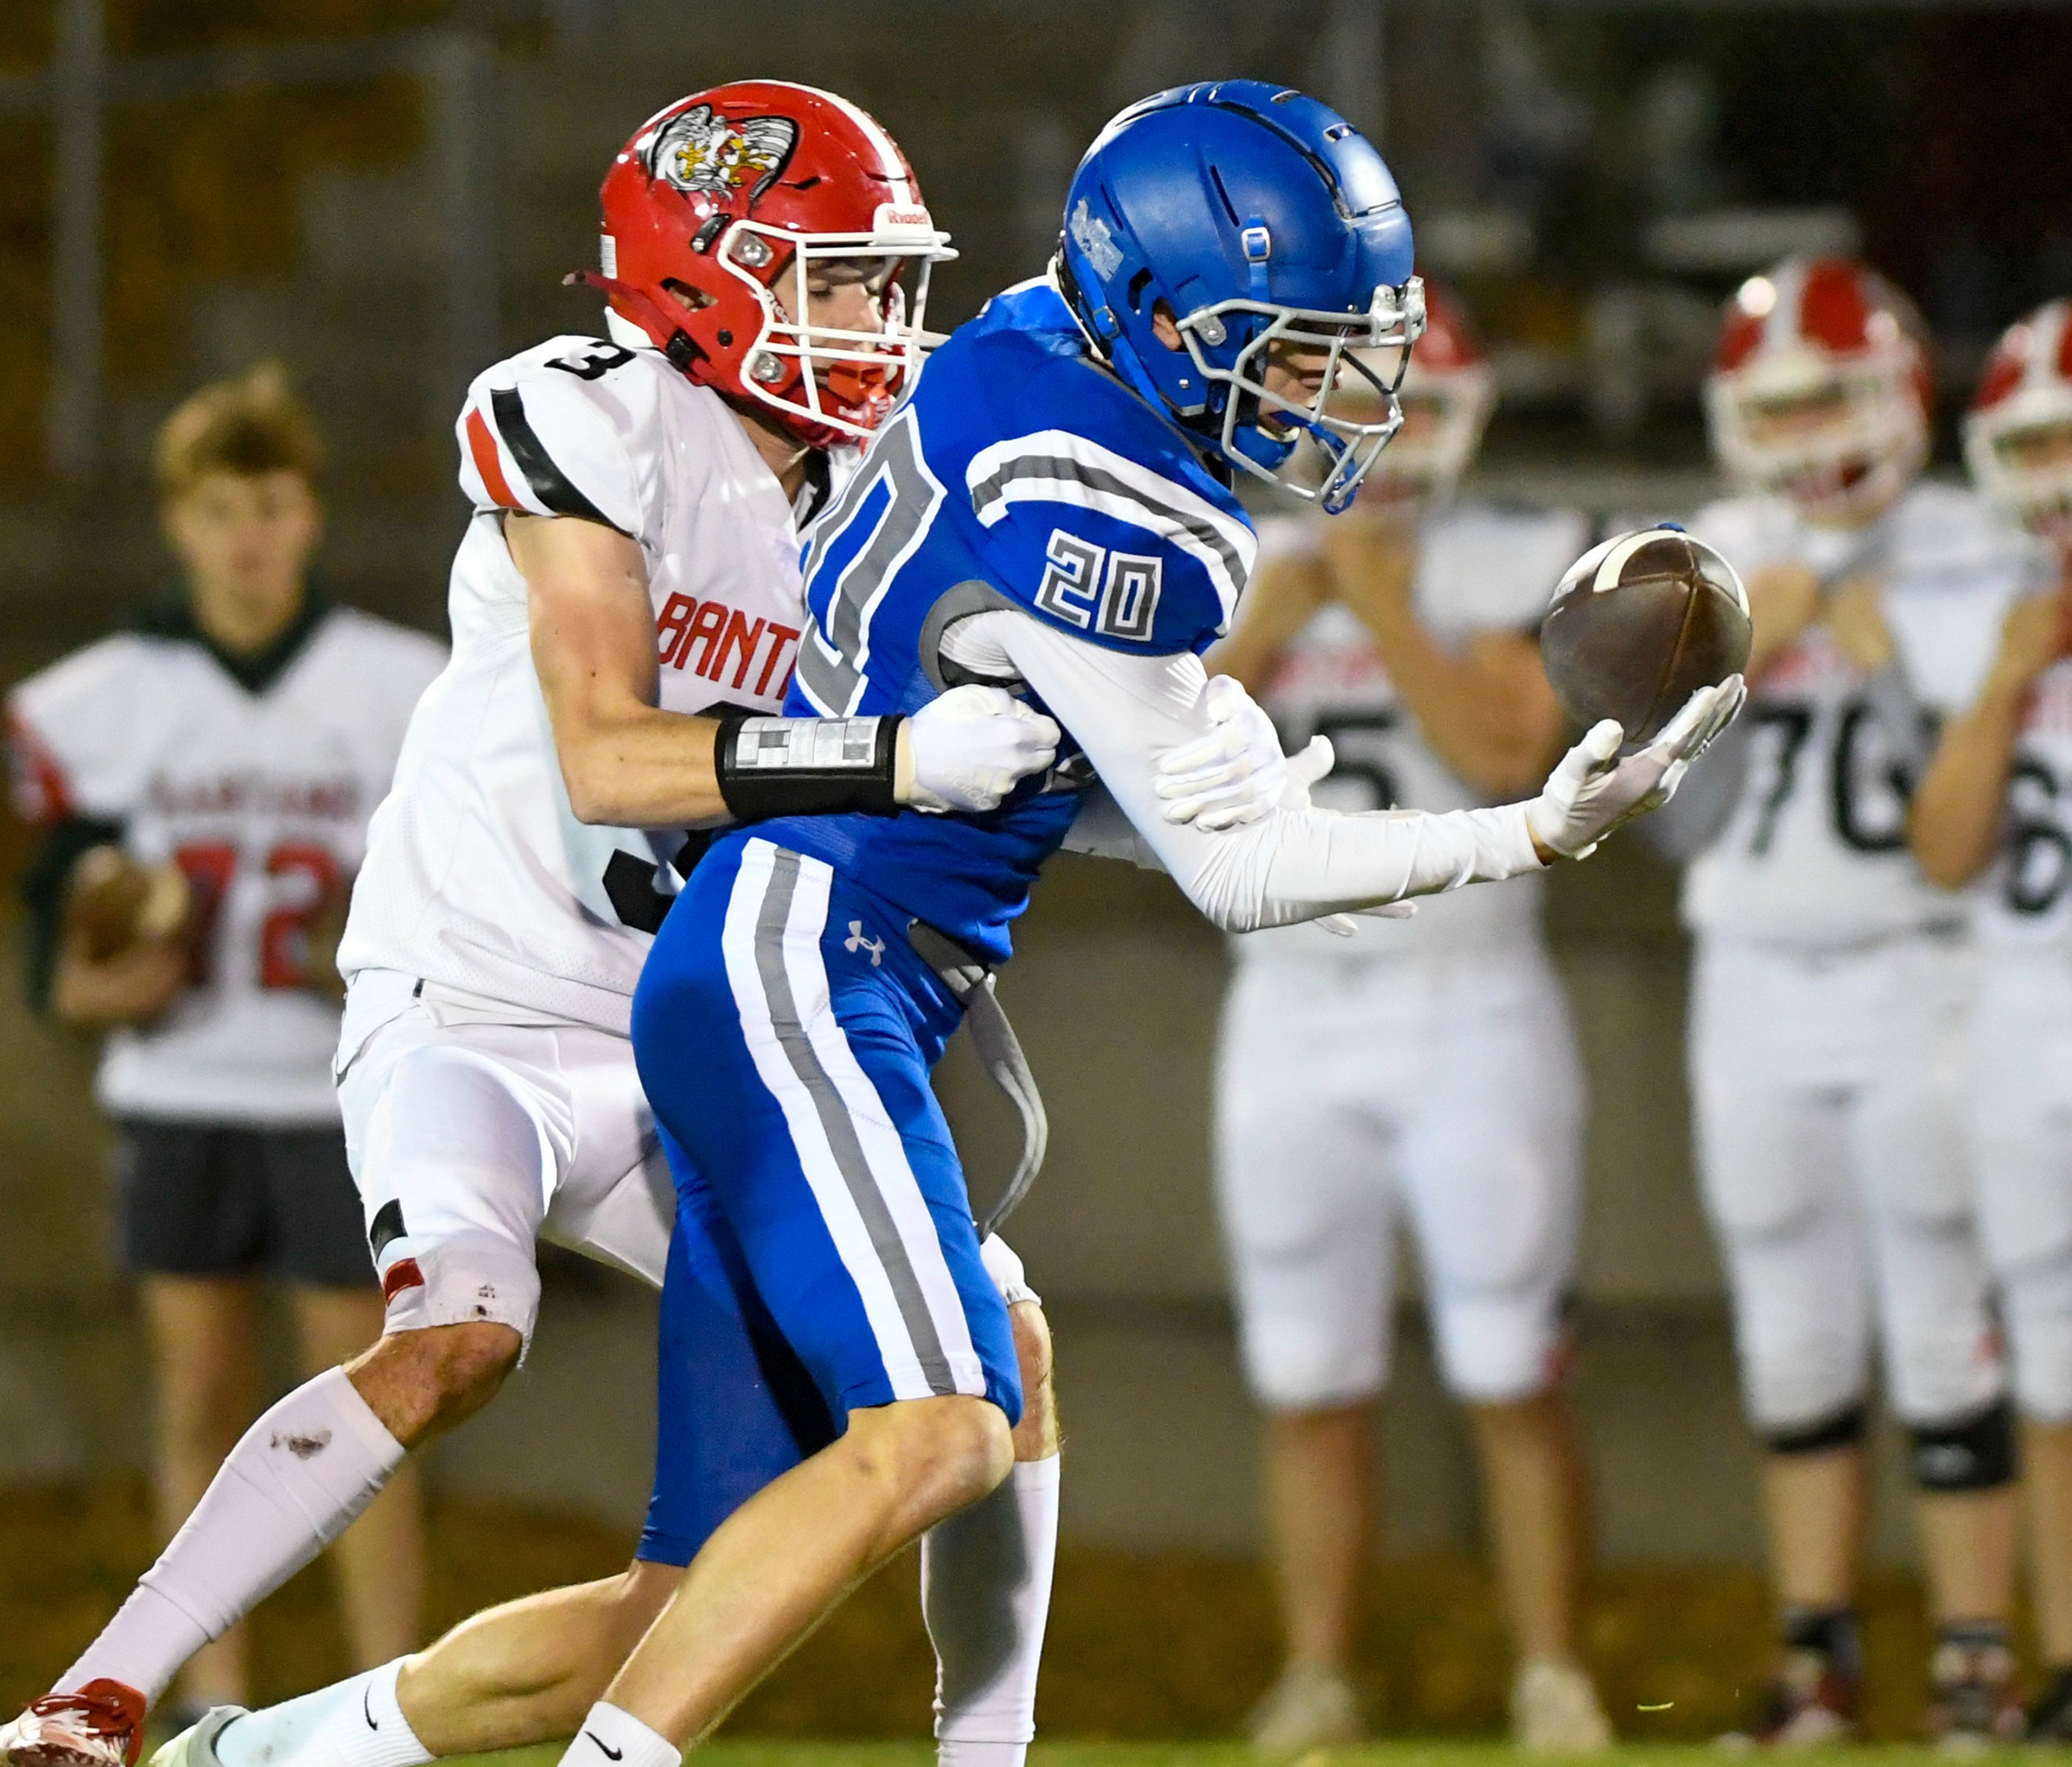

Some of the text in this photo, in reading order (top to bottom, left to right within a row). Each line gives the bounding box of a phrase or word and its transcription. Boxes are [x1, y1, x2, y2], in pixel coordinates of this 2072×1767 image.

[543, 341, 637, 381] 3
[795, 390, 949, 719] 0
[1033, 528, 1163, 642] 20
[657, 591, 801, 701] BANT
[175, 837, 345, 990] 72
